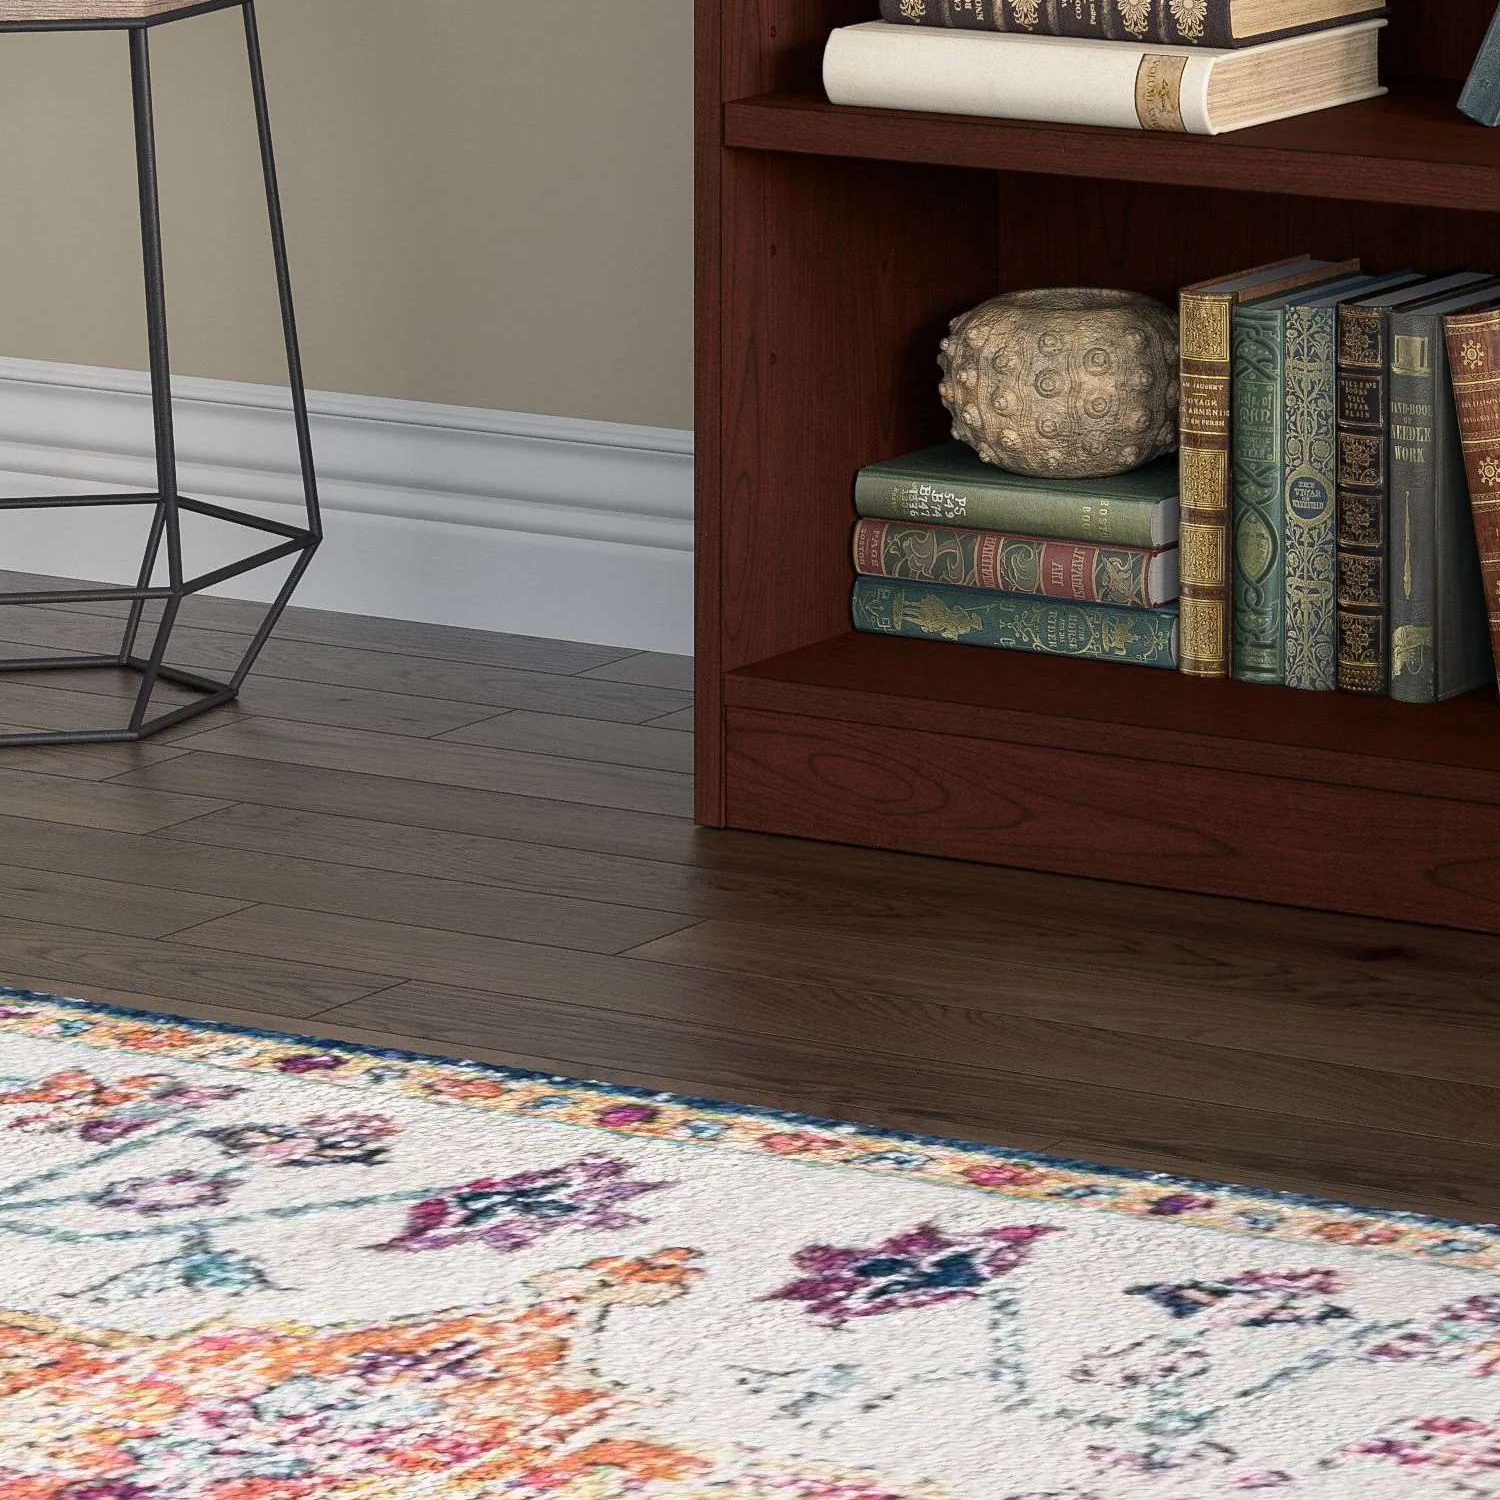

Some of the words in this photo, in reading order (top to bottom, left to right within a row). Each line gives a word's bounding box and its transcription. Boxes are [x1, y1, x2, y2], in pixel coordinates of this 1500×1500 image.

[1089, 4, 1097, 25] Pages
[1341, 380, 1377, 389] MILLER'S
[1345, 402, 1369, 410] SPEAK
[1347, 395, 1365, 403] WILL
[1345, 410, 1370, 418] PLAIN
[1391, 424, 1431, 442] NEEDLE
[1394, 445, 1425, 463] WORK
[1294, 488, 1322, 498] VICAR
[944, 491, 955, 519] 549
[954, 497, 966, 517] PS
[1082, 506, 1091, 536] BOO
[1099, 500, 1109, 541] BOSTO
[859, 528, 867, 565] BOSTON
[871, 530, 880, 568] PAGE
[1051, 561, 1064, 587] ART
[1047, 610, 1058, 649] RIDER
